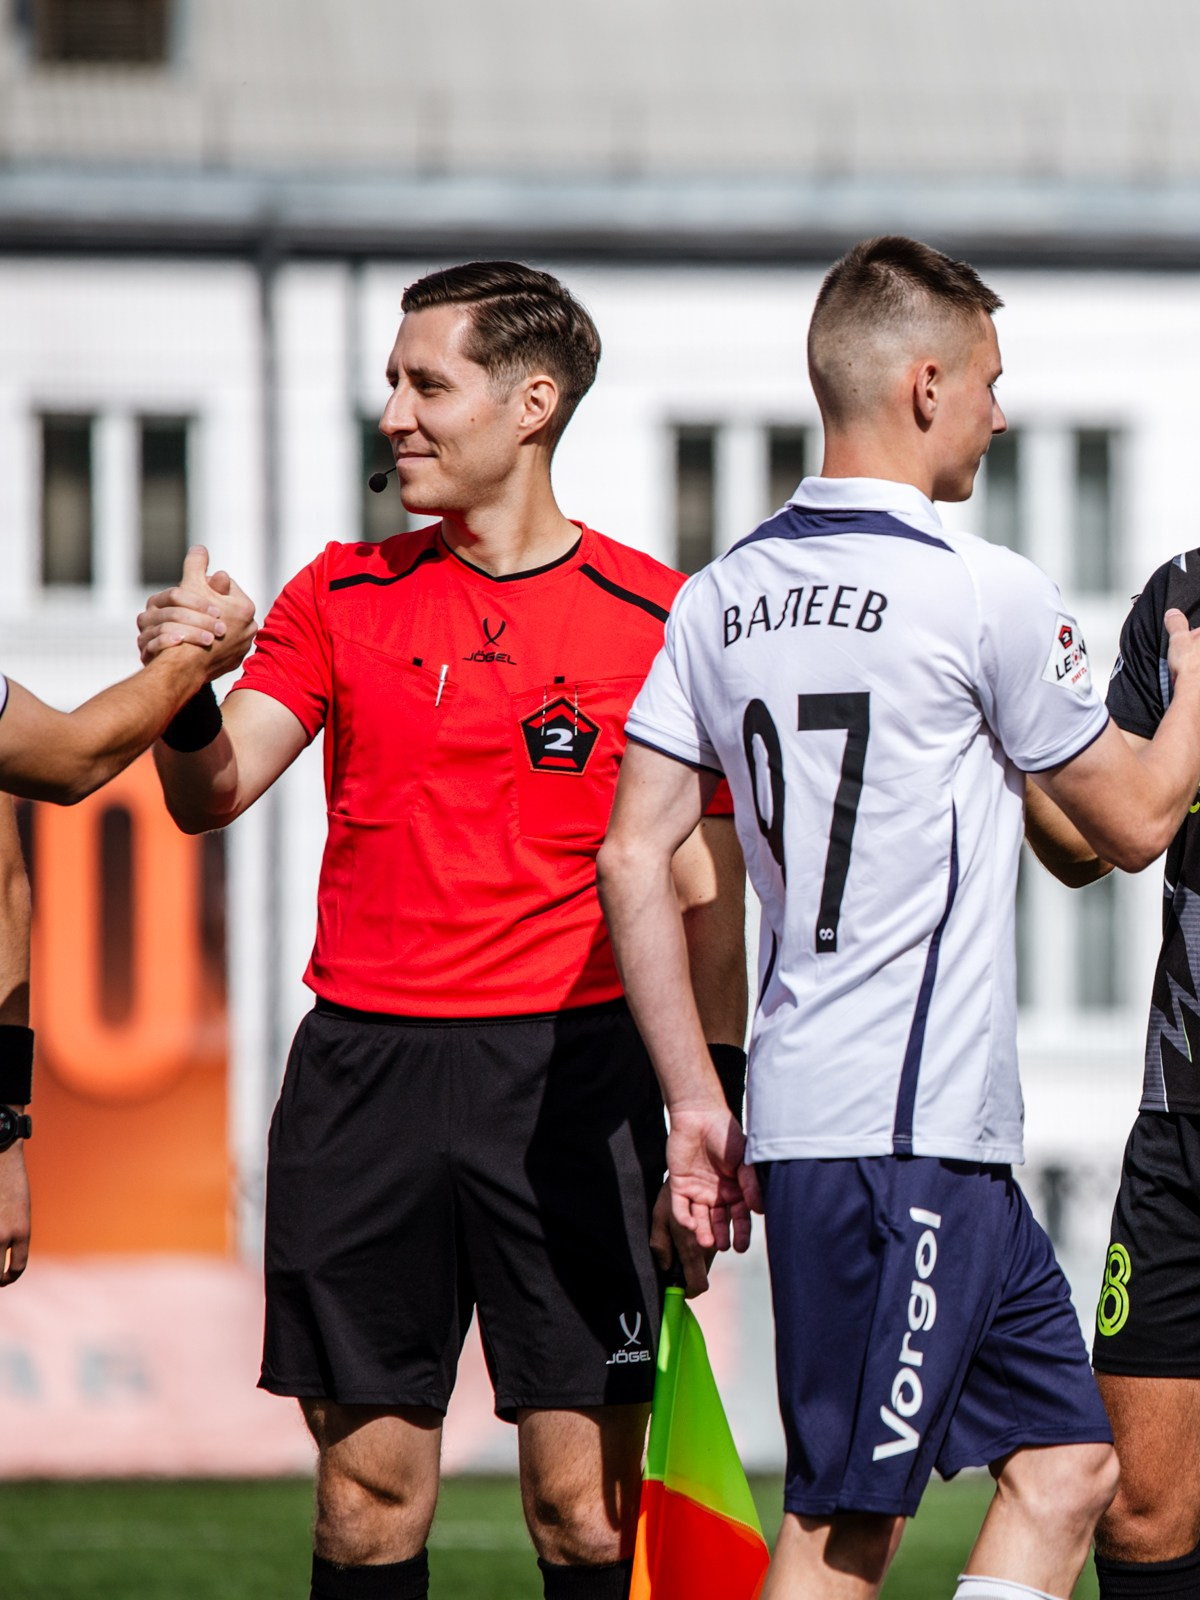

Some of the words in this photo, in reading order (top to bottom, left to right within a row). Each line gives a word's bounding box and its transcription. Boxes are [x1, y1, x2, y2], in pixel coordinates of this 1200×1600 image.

[723, 585, 888, 649] ВАЛЕЕВ
[1062, 632, 1071, 644] 2
[462, 650, 518, 666] JÖGEL
[1055, 638, 1087, 681] LEON
[544, 727, 574, 752] 2
[743, 691, 871, 954] 97
[1097, 1242, 1132, 1337] 8
[872, 1206, 942, 1461] Vorgol
